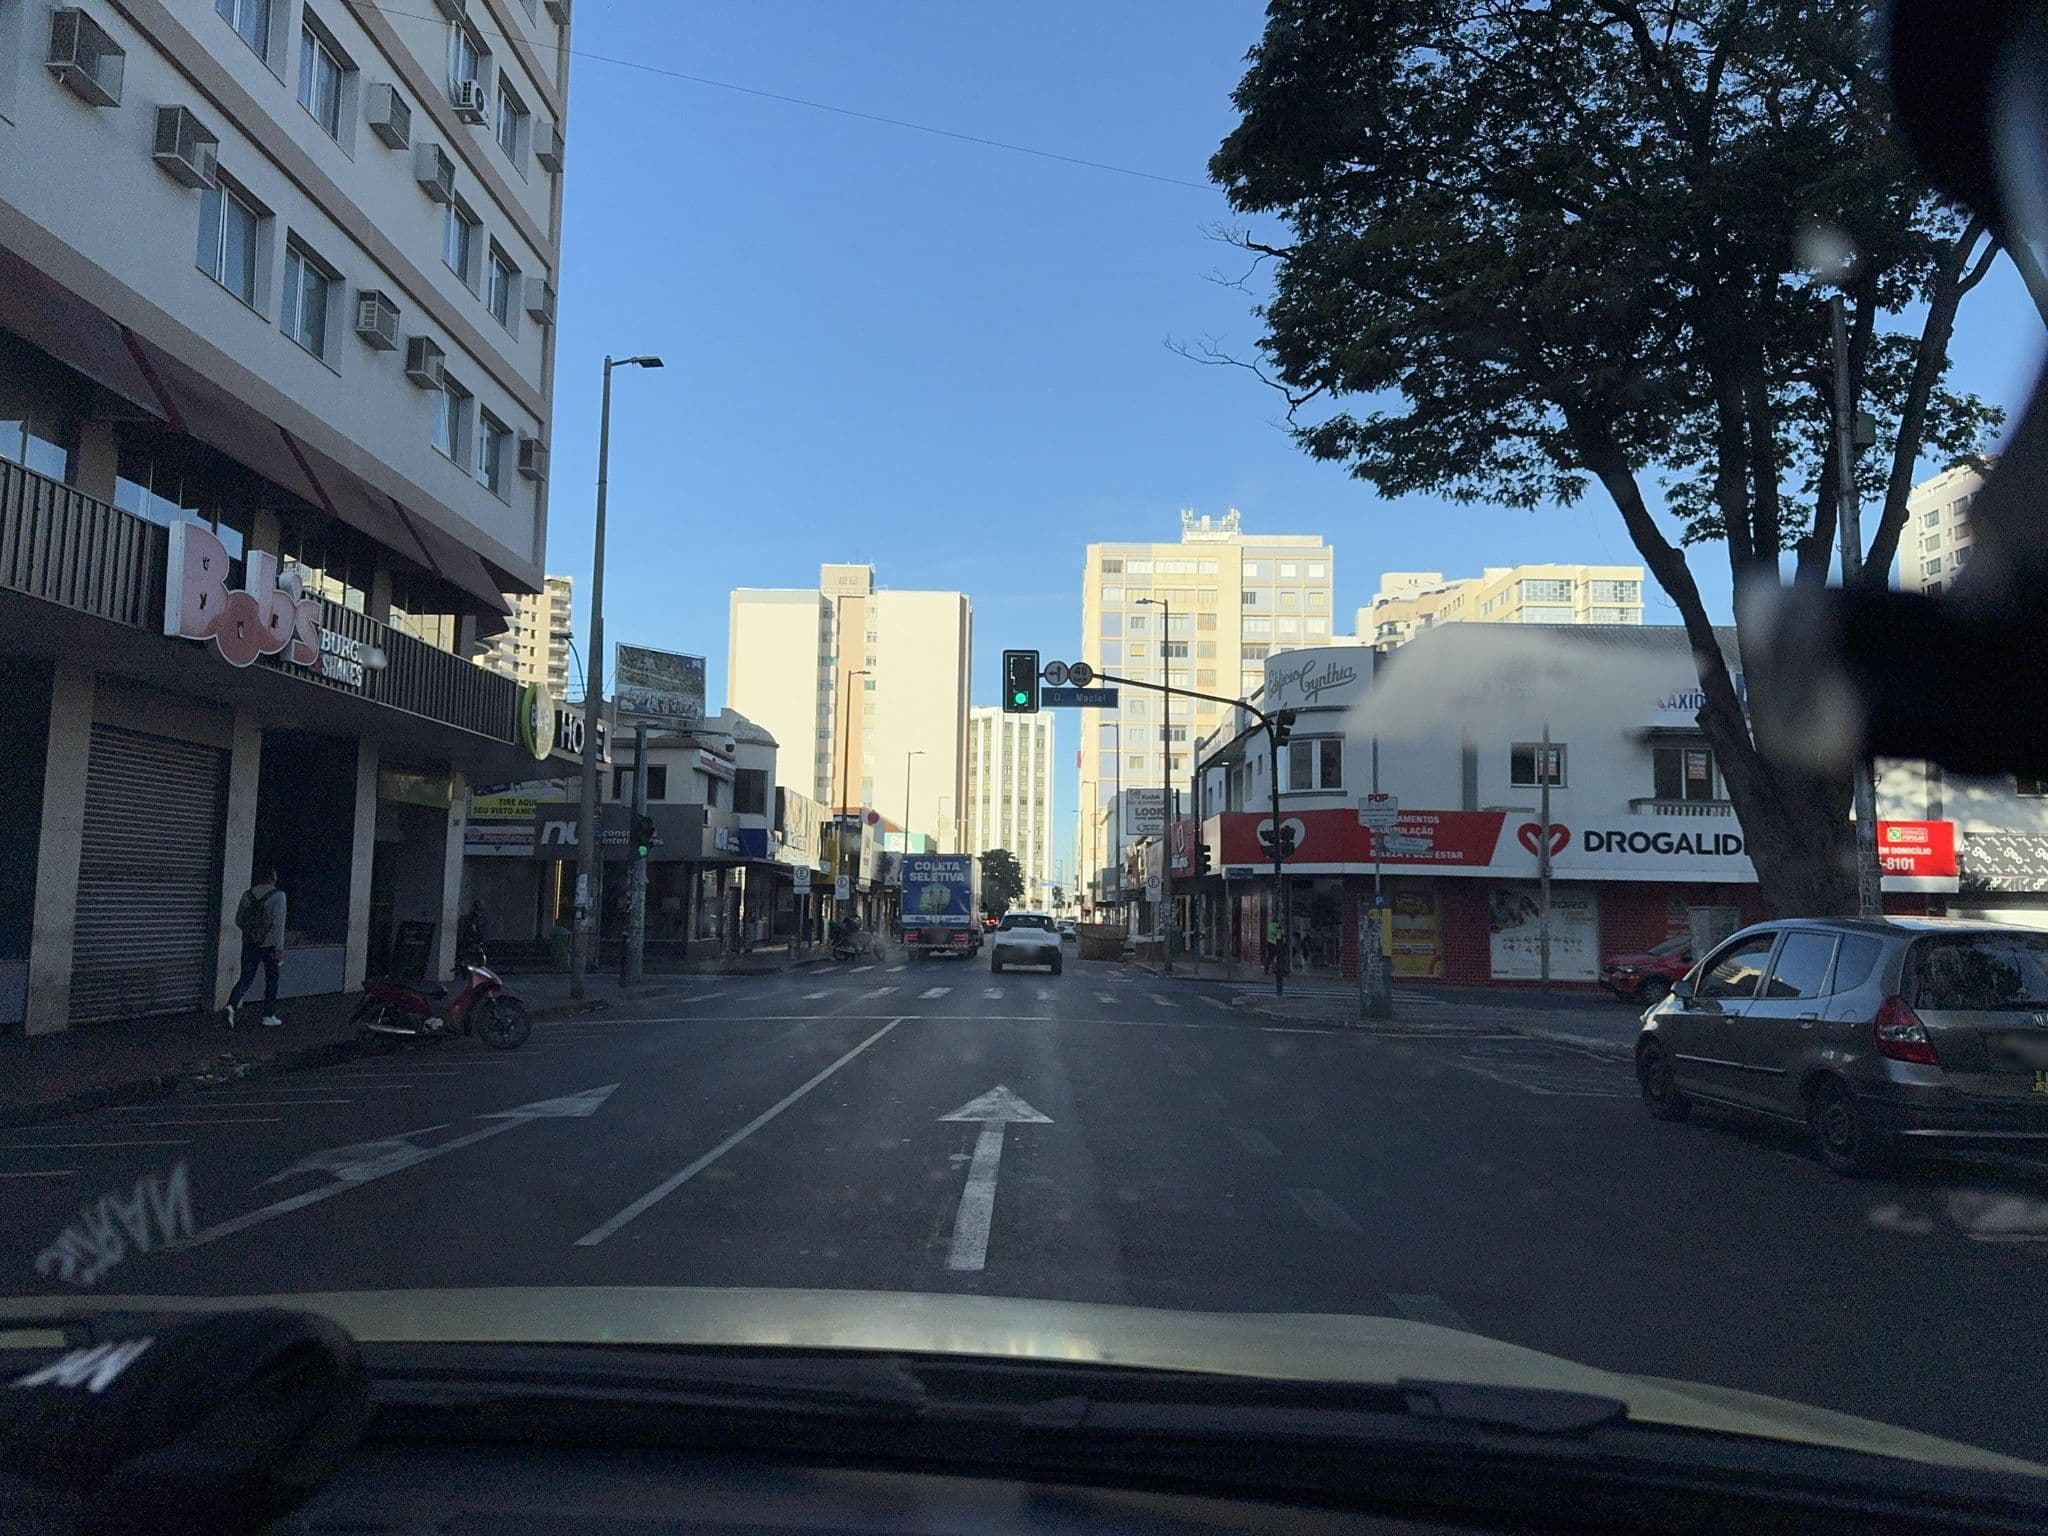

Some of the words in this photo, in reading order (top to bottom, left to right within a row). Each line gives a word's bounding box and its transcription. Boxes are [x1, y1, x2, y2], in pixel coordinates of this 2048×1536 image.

[321, 653, 363, 687] SHAKES
[1074, 666, 1087, 676] 40
[1300, 660, 1357, 703] Cynthia
[1667, 694, 1705, 710] AXIO
[560, 710, 612, 764] HOEL
[1368, 794, 1388, 802] POP
[1583, 830, 1749, 856] DROGALID
[1435, 850, 1463, 859] ESTAR
[1890, 846, 1932, 856] DOMICÍLIO
[914, 861, 961, 871] COLETA
[1880, 857, 1915, 871] -8101
[909, 872, 966, 882] SELETIVA
